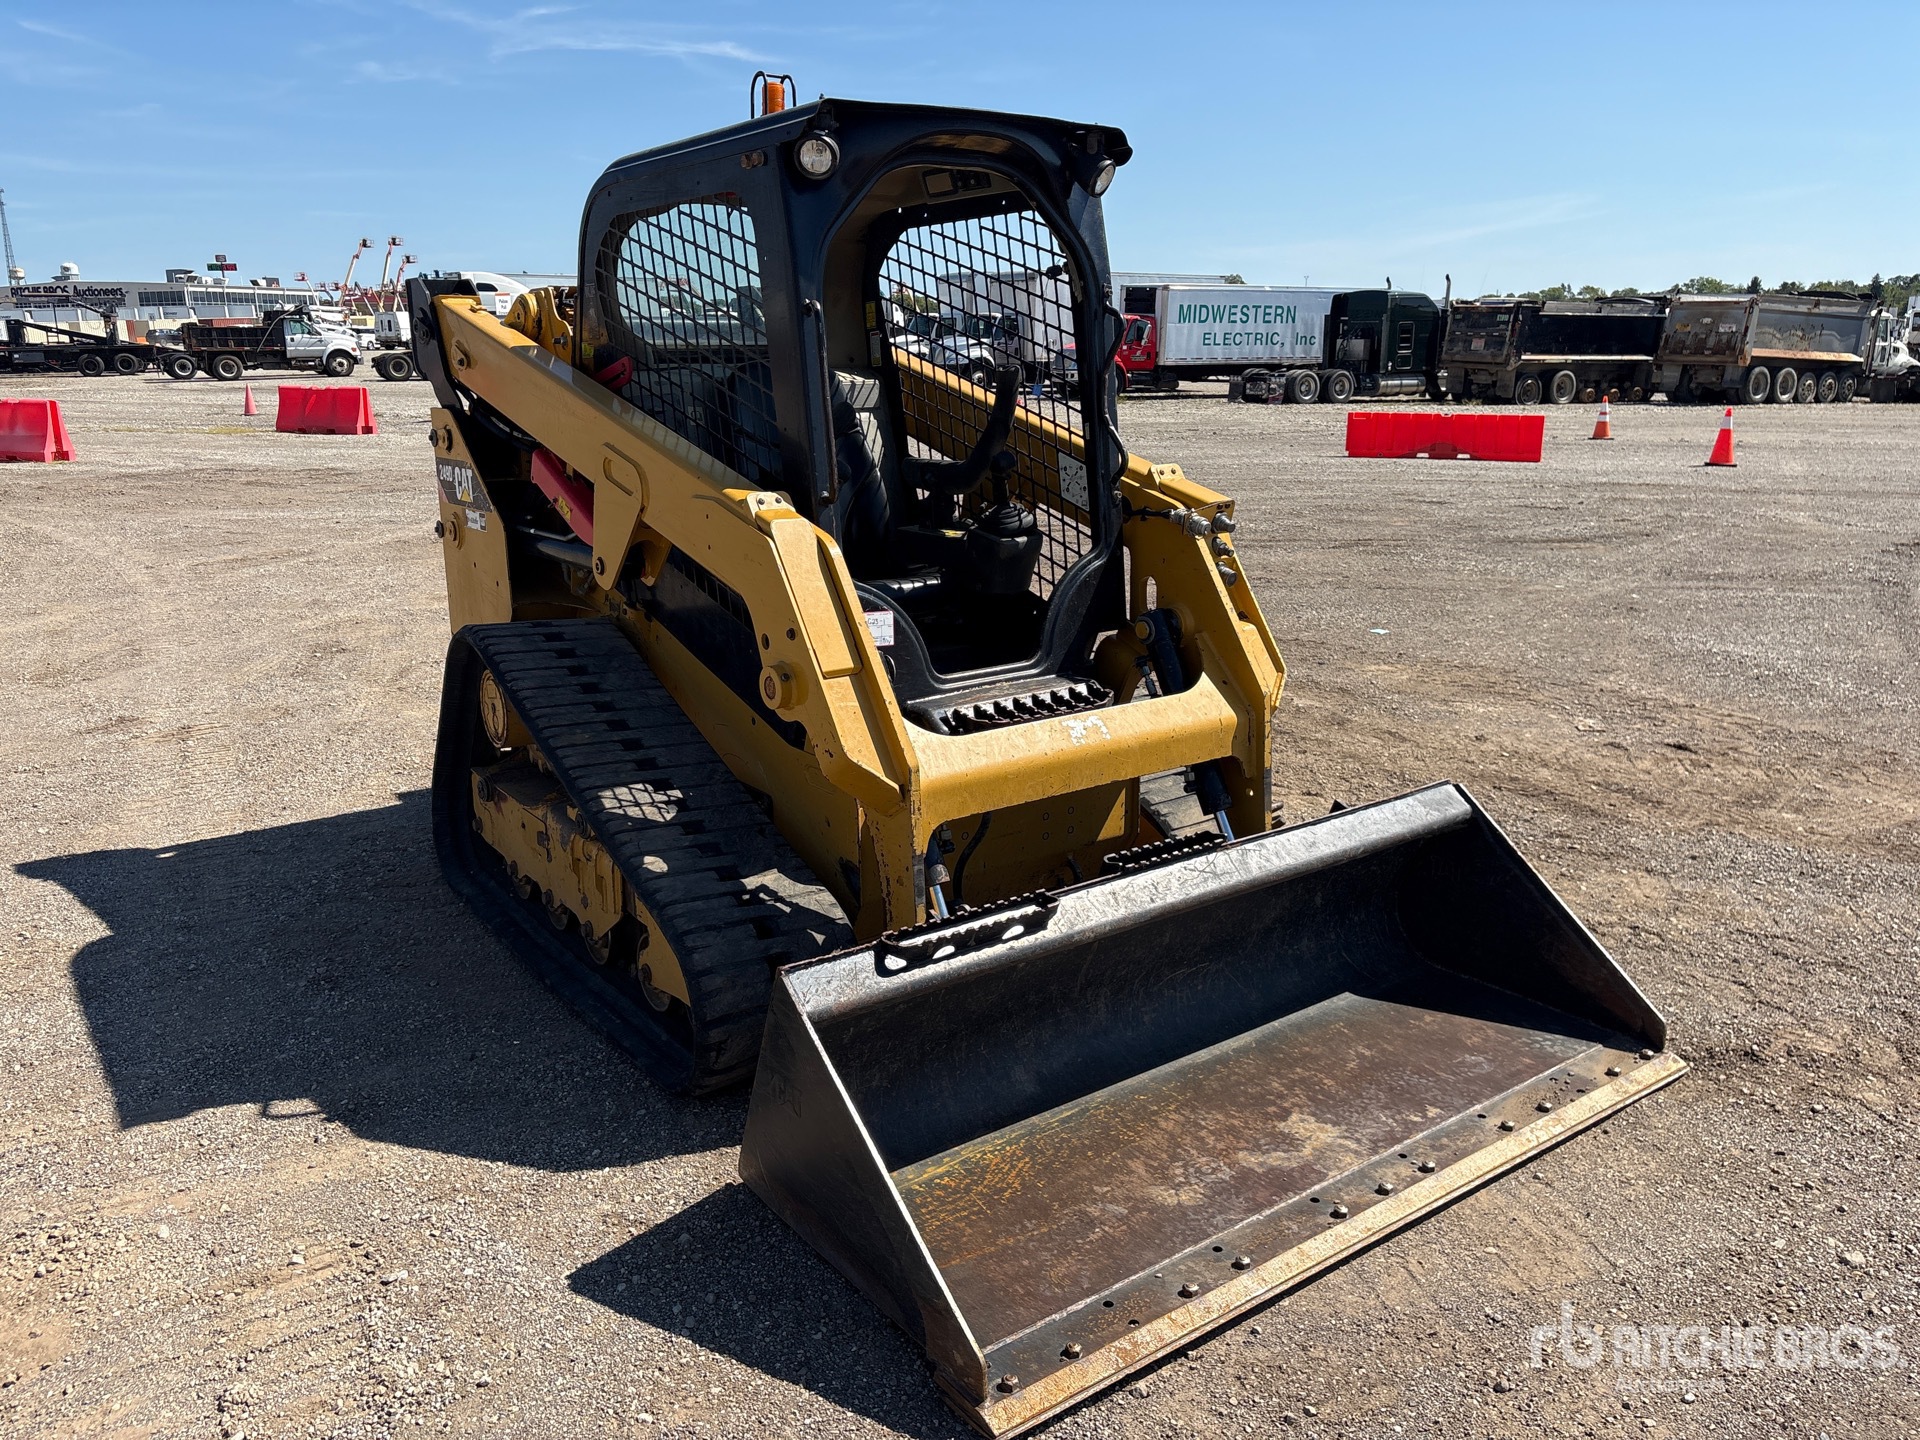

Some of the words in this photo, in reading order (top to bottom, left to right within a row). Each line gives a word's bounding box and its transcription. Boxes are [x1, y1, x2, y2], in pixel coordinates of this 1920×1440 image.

[73, 285, 123, 298] Auctioneers
[1178, 304, 1297, 324] MIDWESTERN
[1202, 332, 1285, 348] ELECTRIC,
[1295, 332, 1317, 346] Inc
[439, 464, 453, 482] 249D
[454, 466, 474, 503] CAT
